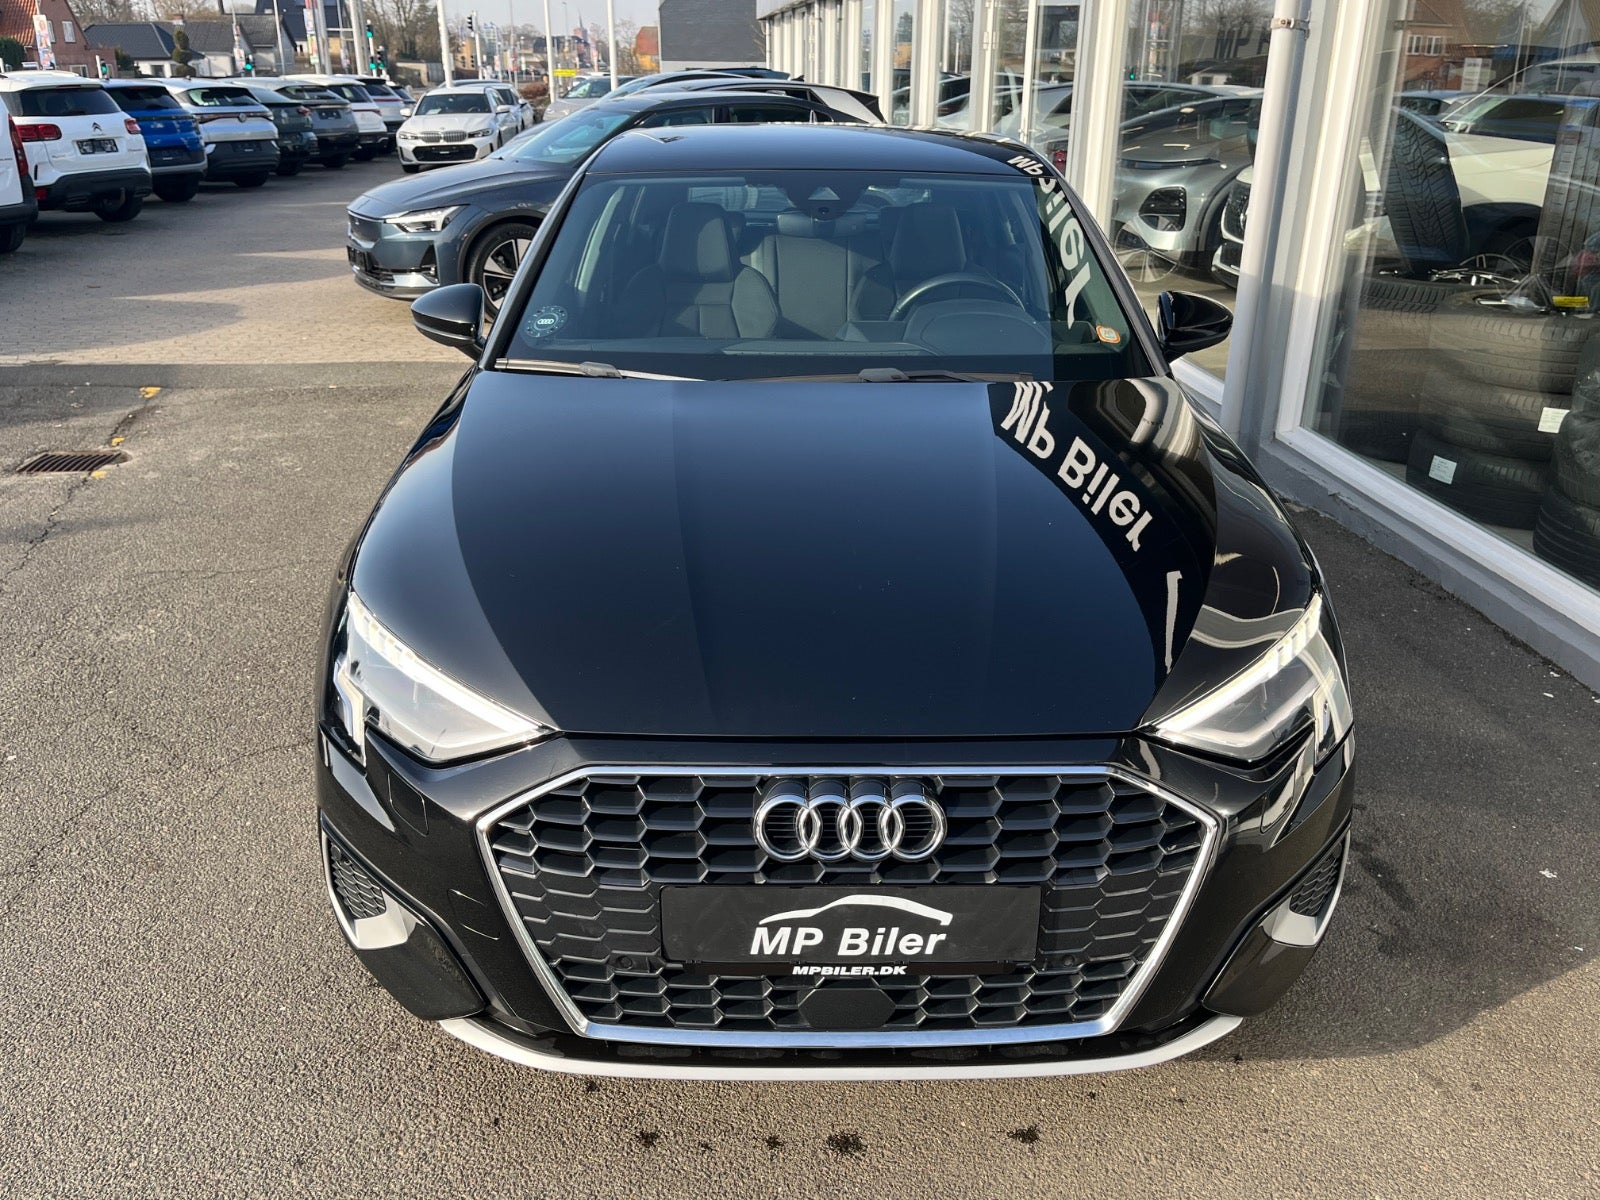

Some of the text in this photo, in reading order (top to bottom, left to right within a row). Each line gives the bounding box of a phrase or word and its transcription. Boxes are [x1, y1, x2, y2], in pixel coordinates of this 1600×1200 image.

[749, 926, 947, 956] MP Biler
[792, 964, 908, 976] MPBILER.DK
